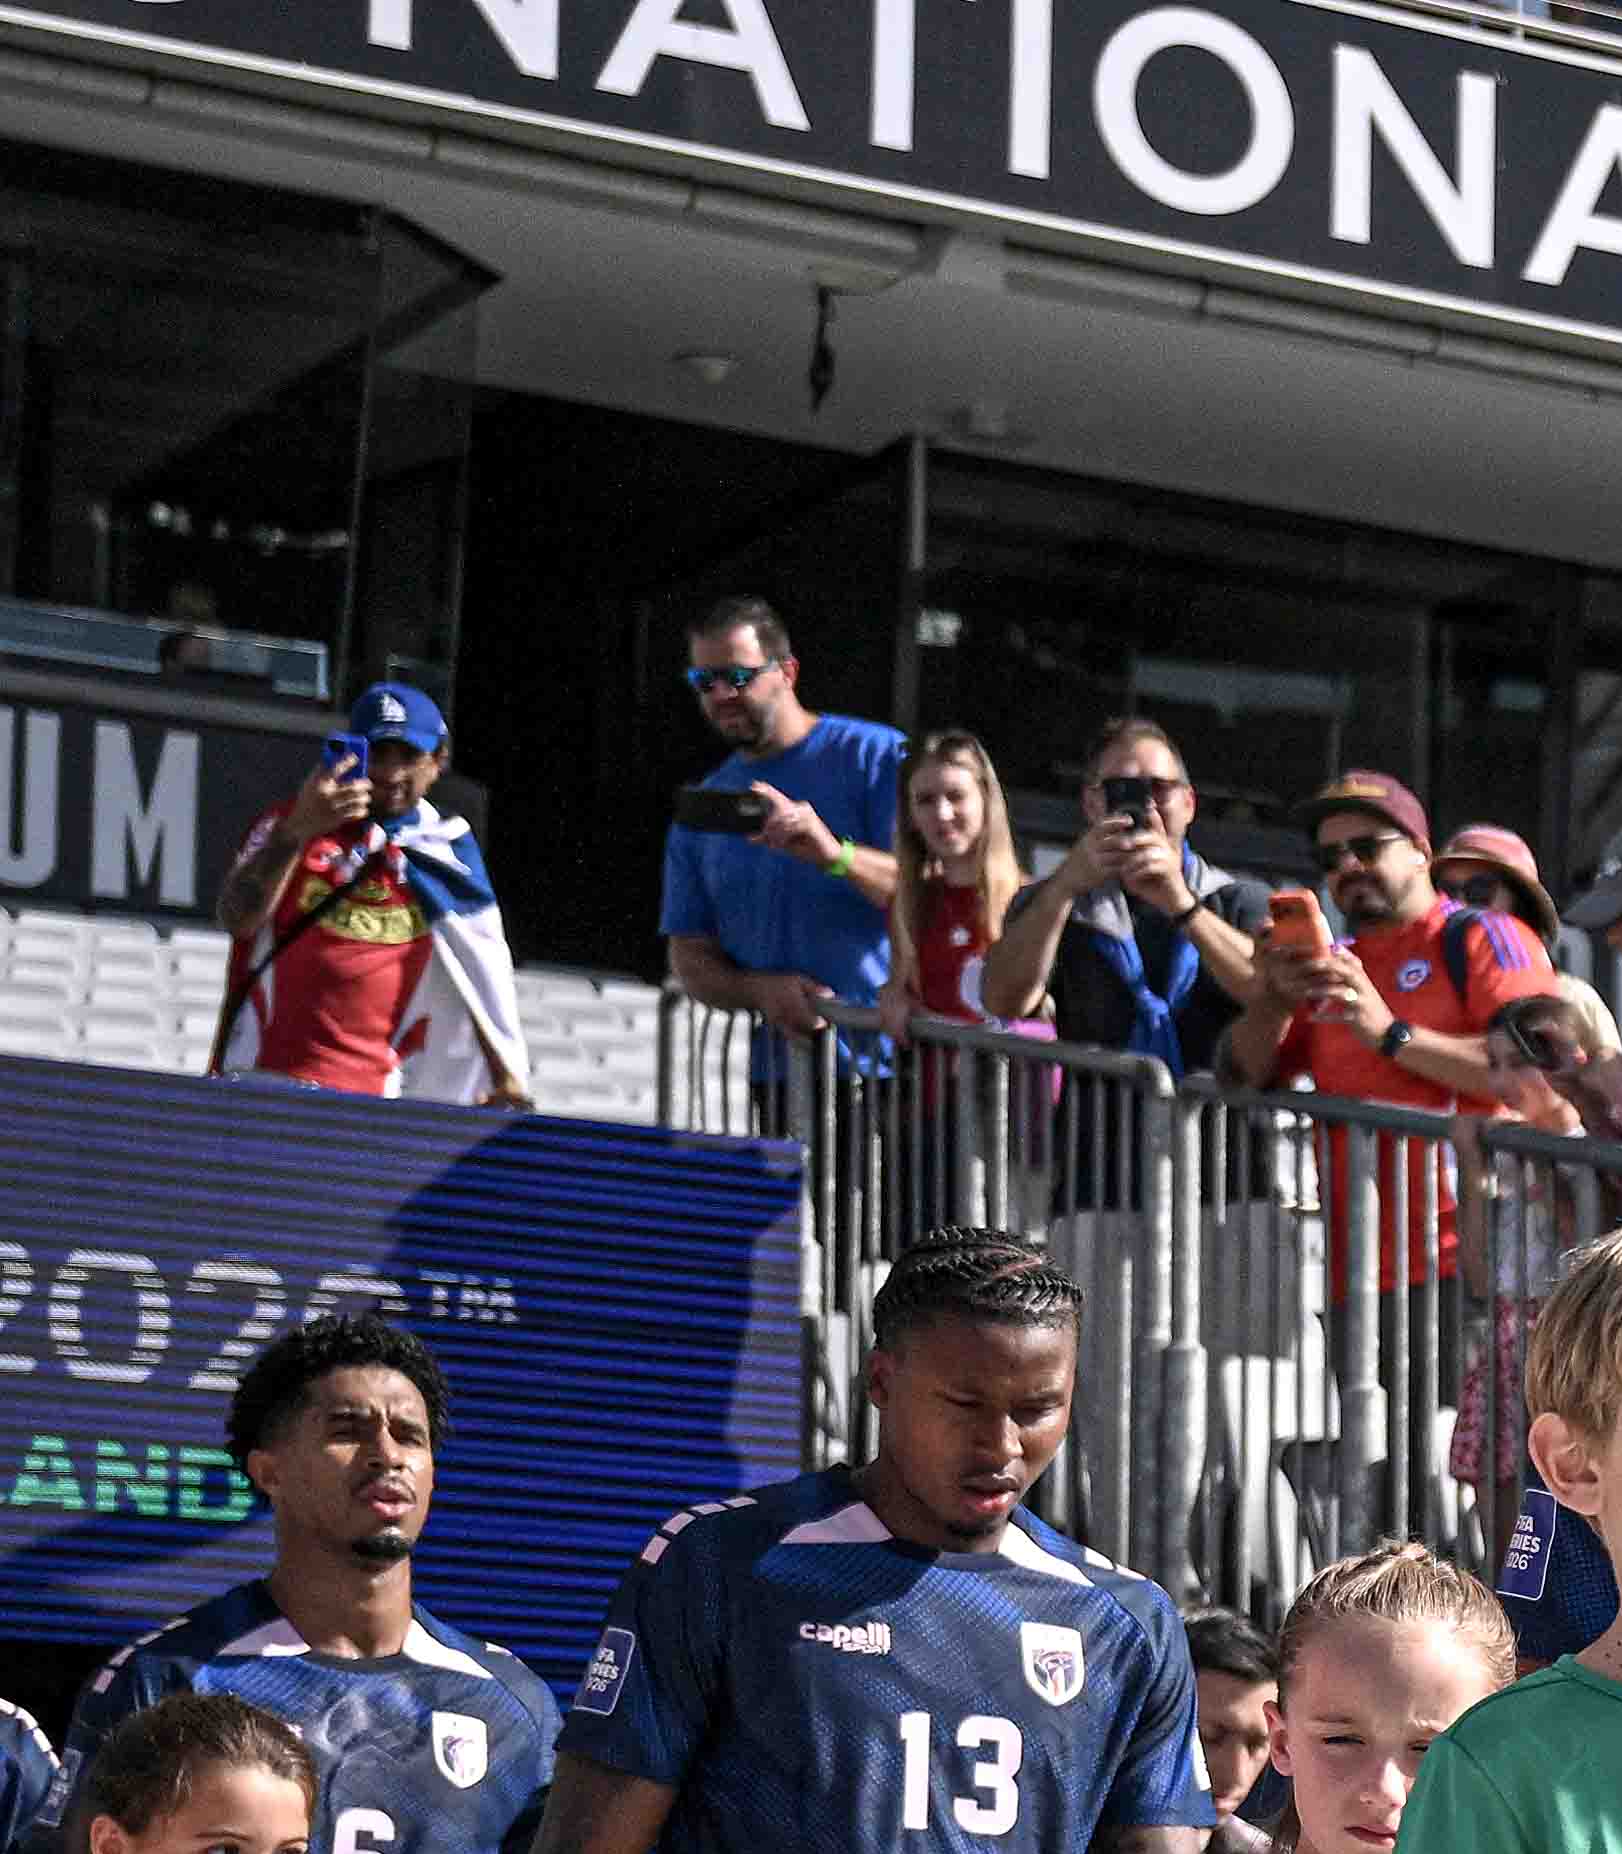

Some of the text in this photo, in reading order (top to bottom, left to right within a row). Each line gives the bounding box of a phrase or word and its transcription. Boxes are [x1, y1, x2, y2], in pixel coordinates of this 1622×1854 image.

[0, 706, 200, 906] UM
[10, 1433, 257, 1522] AND
[800, 1622, 891, 1648] capelli
[897, 1710, 1024, 1837] 13
